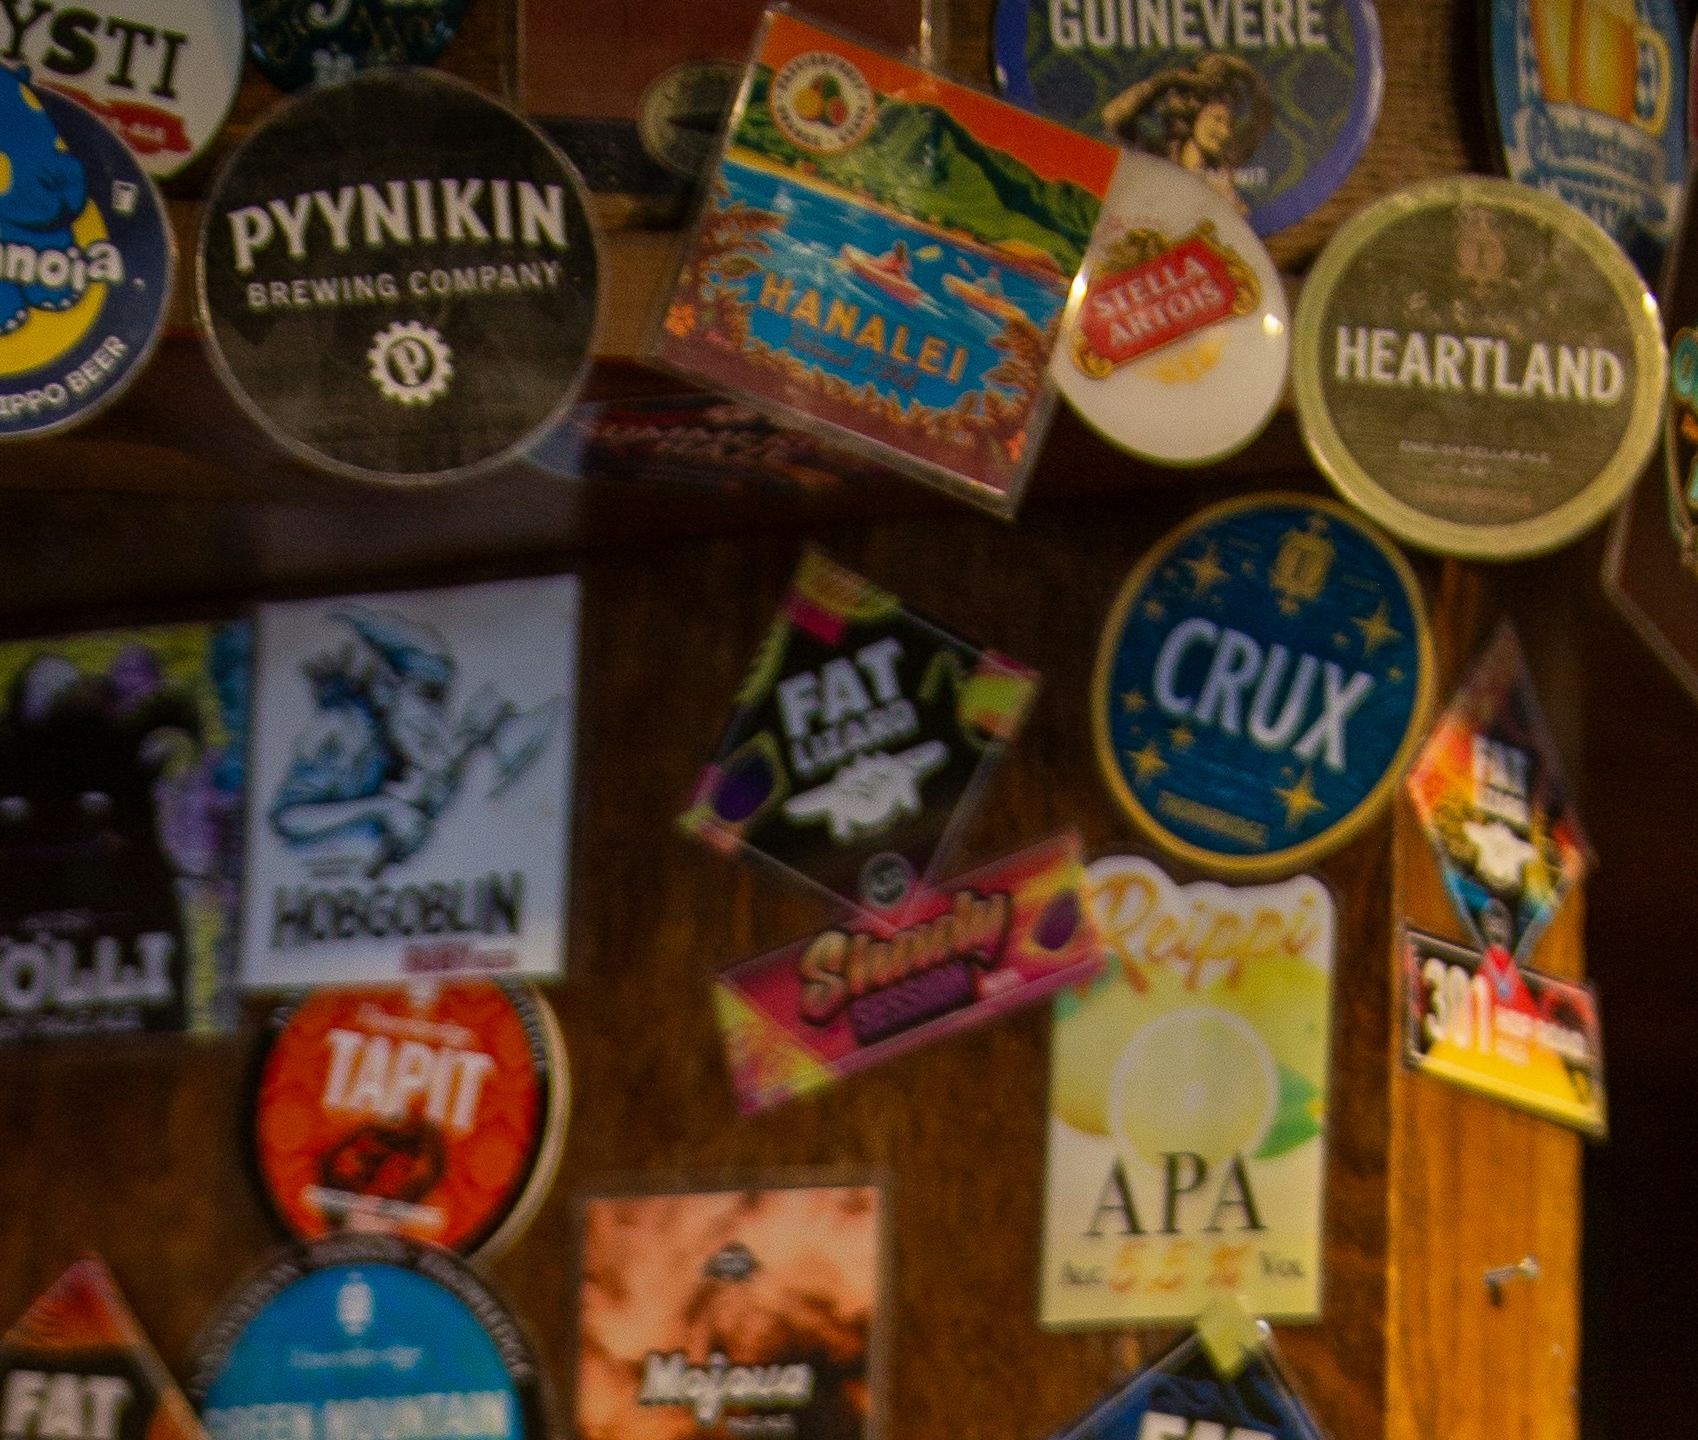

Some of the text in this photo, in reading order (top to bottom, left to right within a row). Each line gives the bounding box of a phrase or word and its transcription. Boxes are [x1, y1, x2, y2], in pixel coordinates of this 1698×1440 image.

[1048, 0, 1330, 52] GUINEVERE
[227, 178, 570, 275] PYYNIKIN
[245, 260, 562, 313] BREWING COMPANY
[758, 272, 970, 384] HANALEI
[1091, 252, 1209, 322] STELLA
[1107, 276, 1225, 355] ARTOIS
[62, 333, 129, 398] BEER
[1333, 324, 1626, 408] HEARTLAND
[775, 635, 905, 742] FAT
[1149, 615, 1377, 775] CRUX
[787, 697, 922, 780] LIZARD
[268, 871, 525, 950] HOBGOBLIN
[1076, 870, 1323, 999] Reippi
[323, 1026, 498, 1135] TAPIT
[1083, 1147, 1271, 1239] APA
